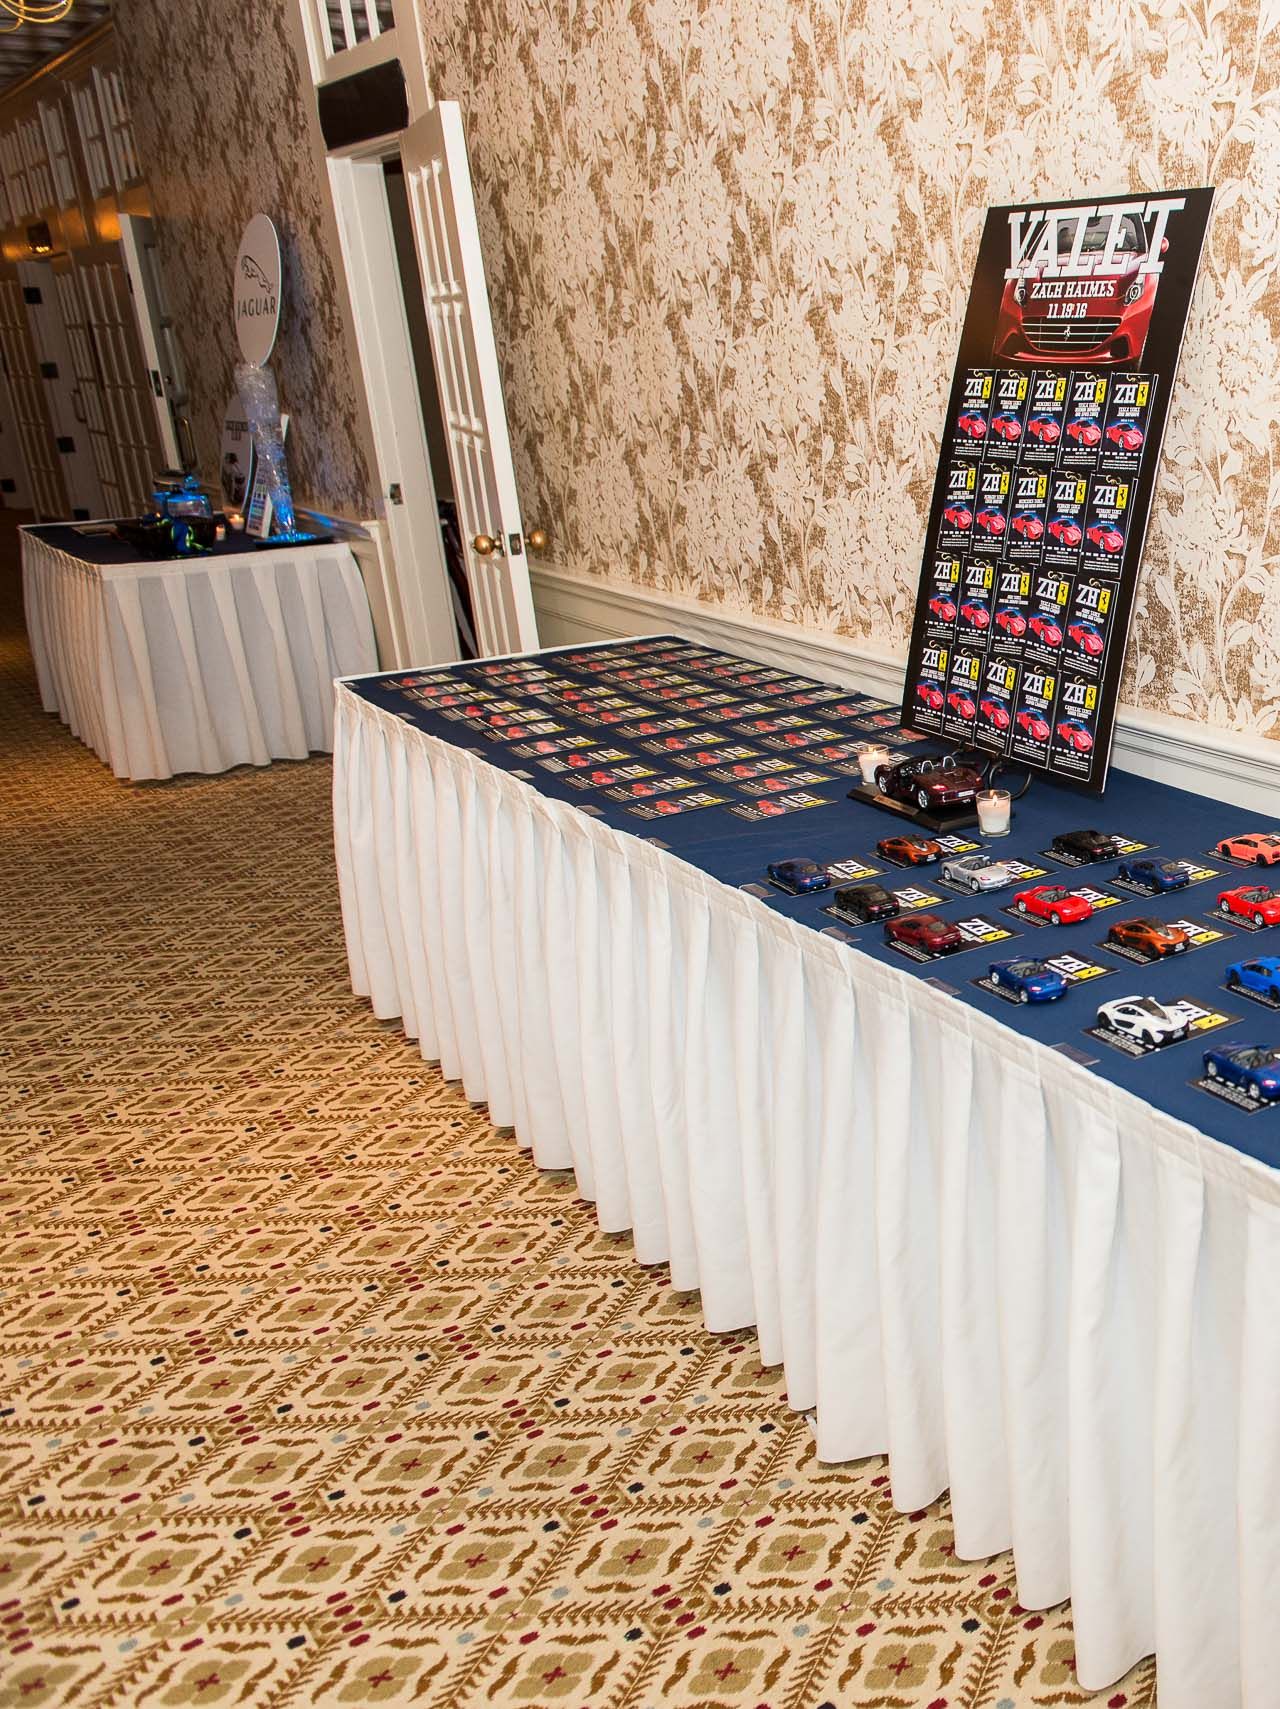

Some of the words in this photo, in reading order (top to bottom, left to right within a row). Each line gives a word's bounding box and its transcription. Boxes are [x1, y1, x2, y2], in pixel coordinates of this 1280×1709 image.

[1004, 197, 1187, 279] VALET
[1030, 282, 1063, 299] ZACH
[1064, 280, 1117, 297] HAIMES
[237, 296, 276, 321] JAGUAR
[1046, 303, 1088, 319] 11.19.16
[964, 378, 984, 396] ZH
[998, 379, 1019, 397] ZH
[1035, 380, 1057, 399] ZH
[1073, 382, 1097, 401] ZH
[1113, 384, 1138, 403] ZH
[949, 470, 968, 488] ZH
[982, 473, 1001, 491] ZH
[1017, 478, 1038, 496] ZH
[1054, 481, 1077, 500] ZH
[1093, 485, 1117, 505] ZH
[934, 561, 952, 579] ZH
[966, 566, 985, 585] ZH
[1000, 573, 1021, 592] ZH
[1036, 577, 1060, 600] ZH
[1075, 584, 1100, 608] ZH
[921, 648, 940, 667] ZH
[952, 655, 971, 676] ZH
[986, 661, 1007, 684] ZH
[1022, 672, 1046, 695] ZH
[1062, 682, 1087, 705] ZH
[936, 835, 968, 848] ZH
[833, 860, 867, 874] ZH
[1005, 861, 1034, 875] ZH
[893, 888, 930, 902] ZH
[959, 918, 998, 935] ZH
[1047, 955, 1091, 974] ZH
